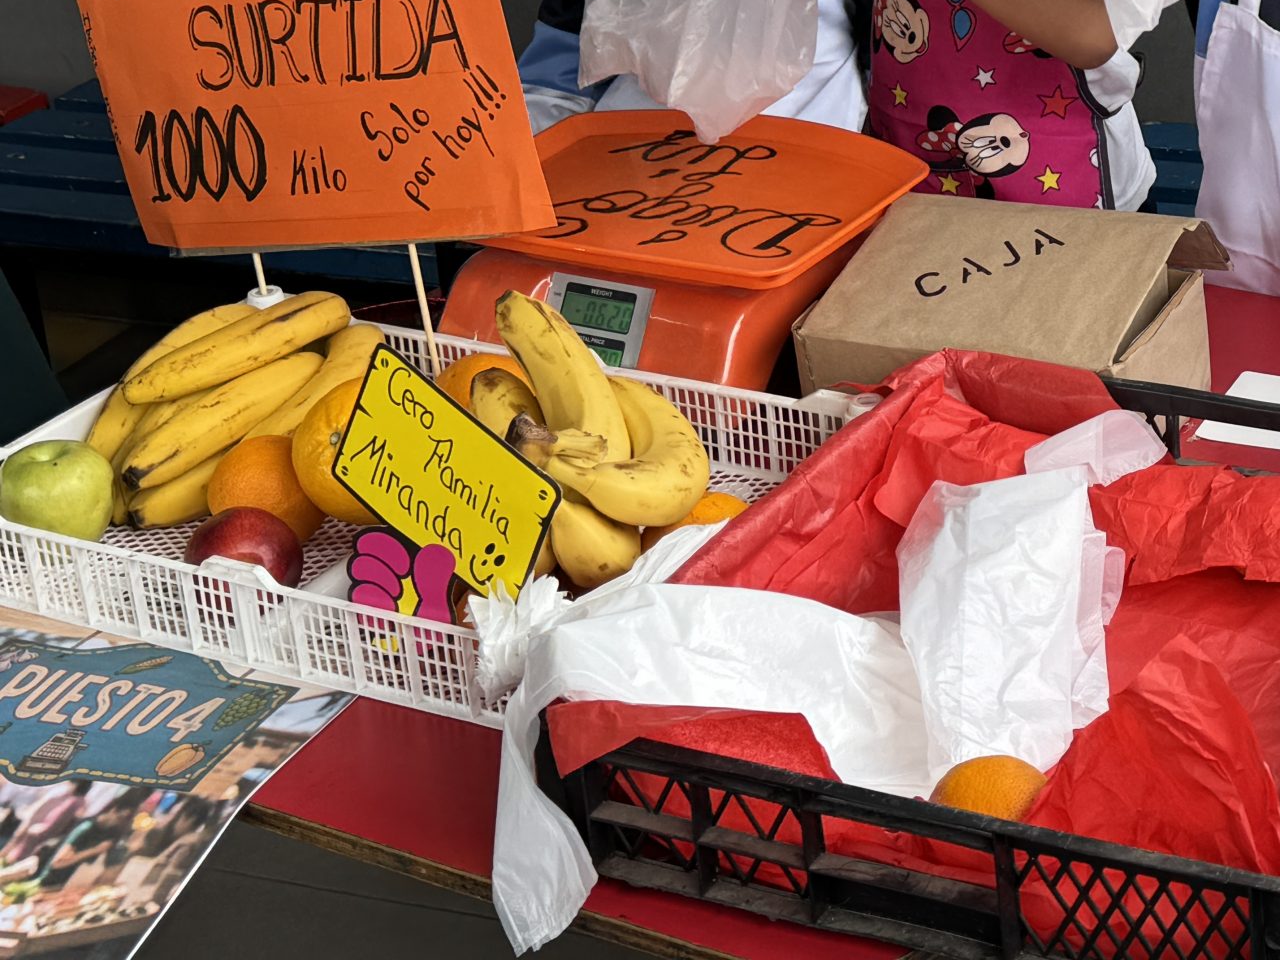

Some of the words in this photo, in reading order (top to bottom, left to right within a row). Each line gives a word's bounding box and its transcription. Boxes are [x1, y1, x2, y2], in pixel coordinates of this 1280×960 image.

[135, 103, 267, 204] 1000
[291, 146, 348, 196] Kilo
[360, 102, 430, 161] Solo
[404, 155, 437, 211] por
[445, 63, 508, 159] hoy!!!
[914, 228, 1065, 298] CAJA
[349, 434, 466, 560] Miranda
[386, 365, 435, 430] Cero
[423, 434, 513, 539] Familia
[0, 663, 190, 736] PUESTO
[166, 696, 227, 743] 4
